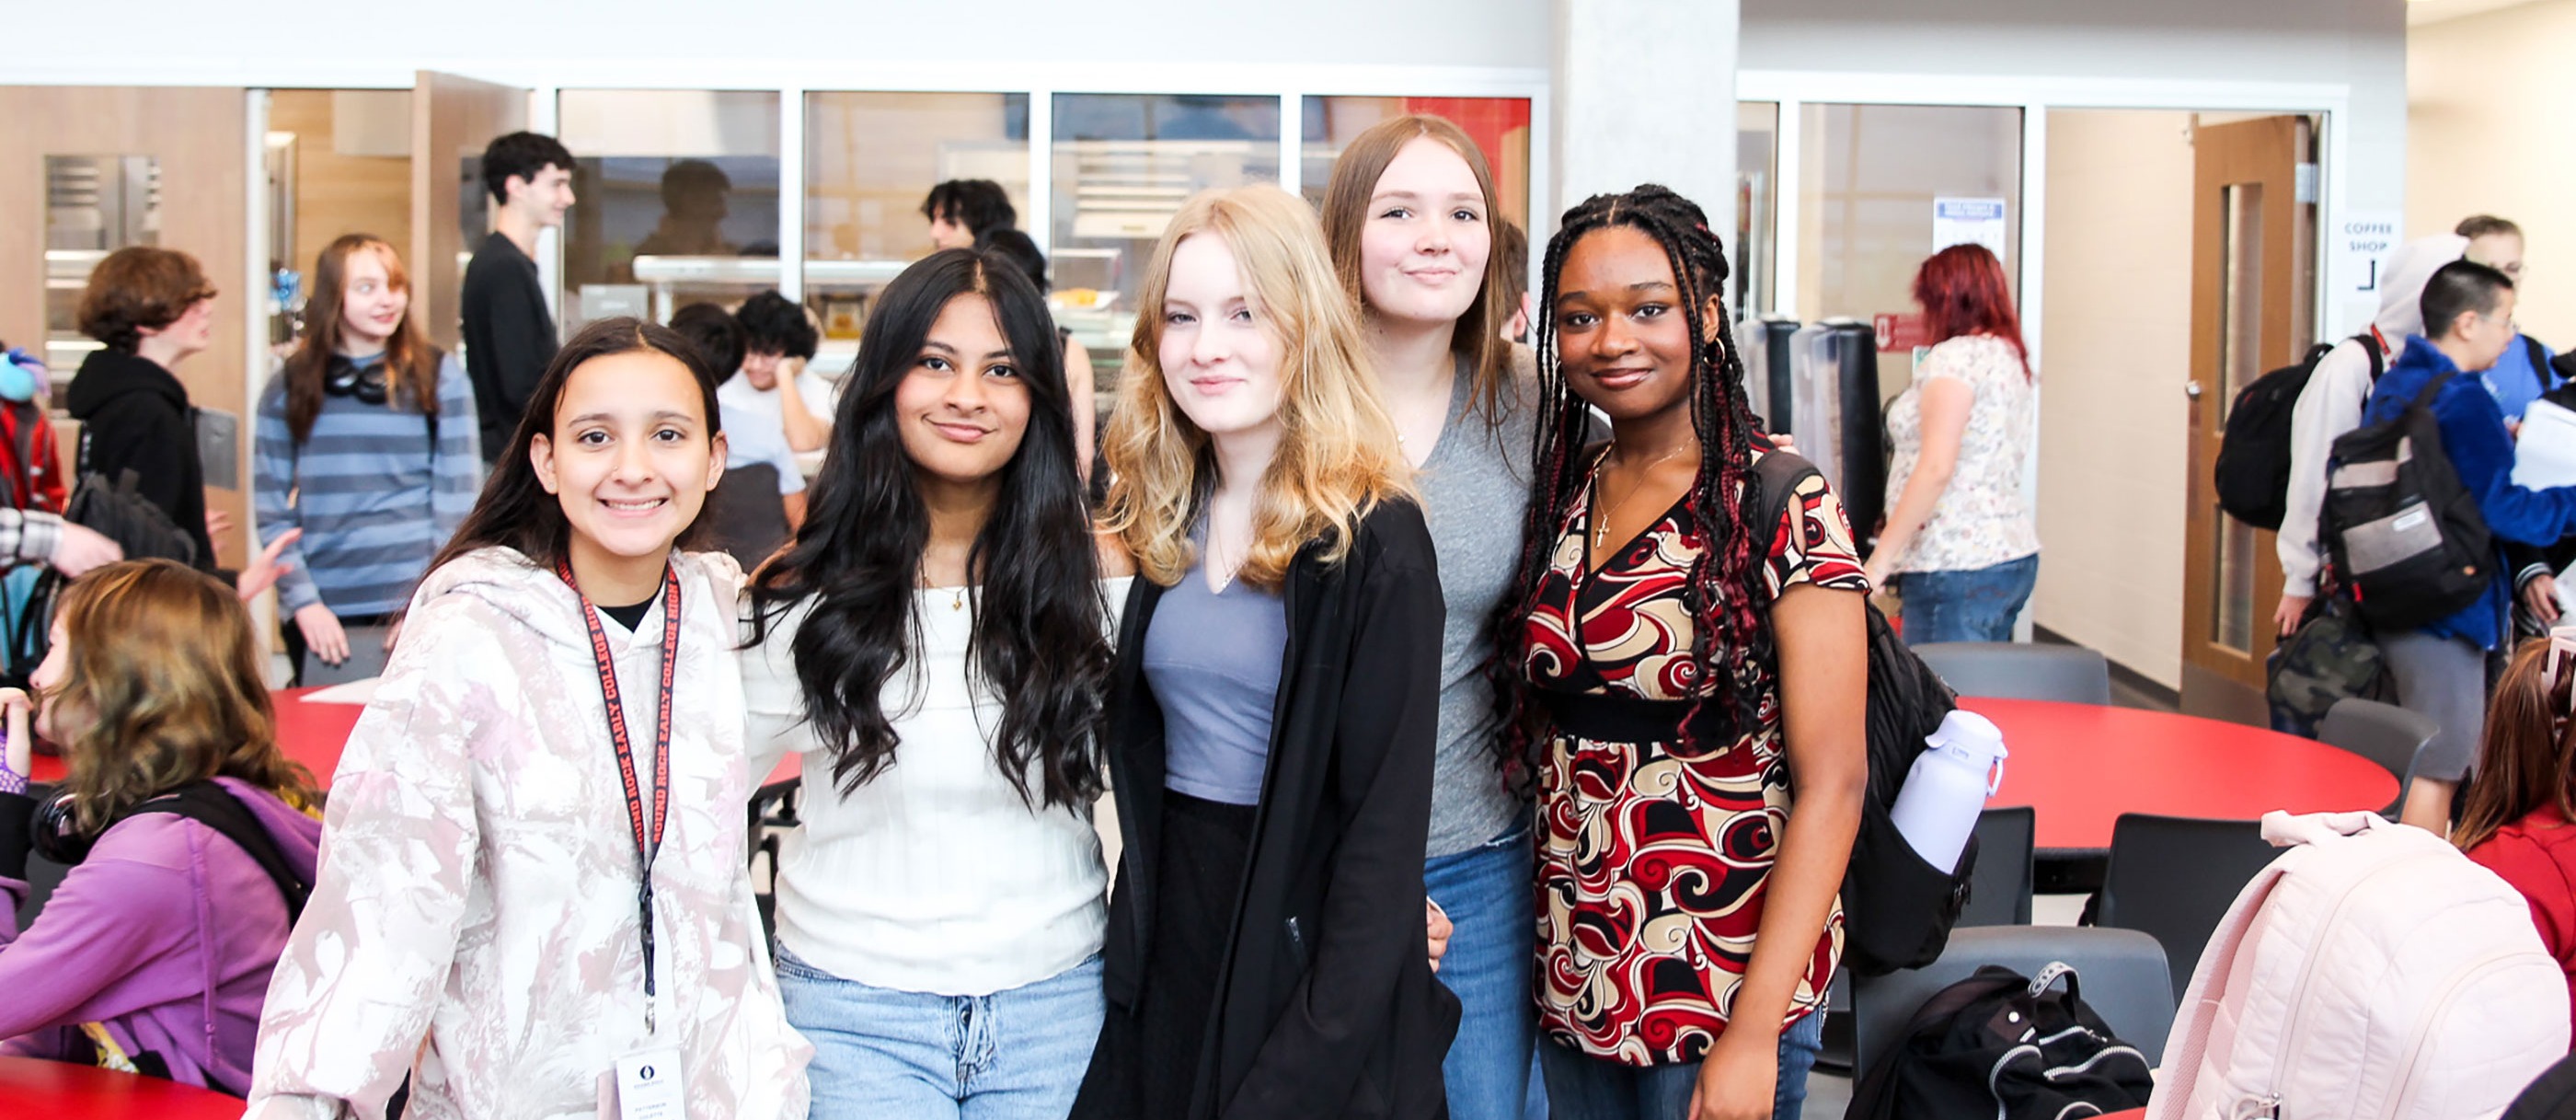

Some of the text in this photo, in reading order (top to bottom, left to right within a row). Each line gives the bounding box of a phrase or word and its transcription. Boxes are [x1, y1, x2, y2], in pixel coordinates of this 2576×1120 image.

[2344, 222, 2392, 235] COFFEE
[2349, 240, 2387, 252] SHOP
[667, 583, 680, 619] HIGH
[592, 632, 617, 700] COLLEGE
[662, 621, 678, 688] COLLEGE
[608, 701, 629, 755] EARLY
[658, 688, 671, 743] EARLY
[619, 756, 638, 799] ROCK
[656, 744, 668, 787] ROCK
